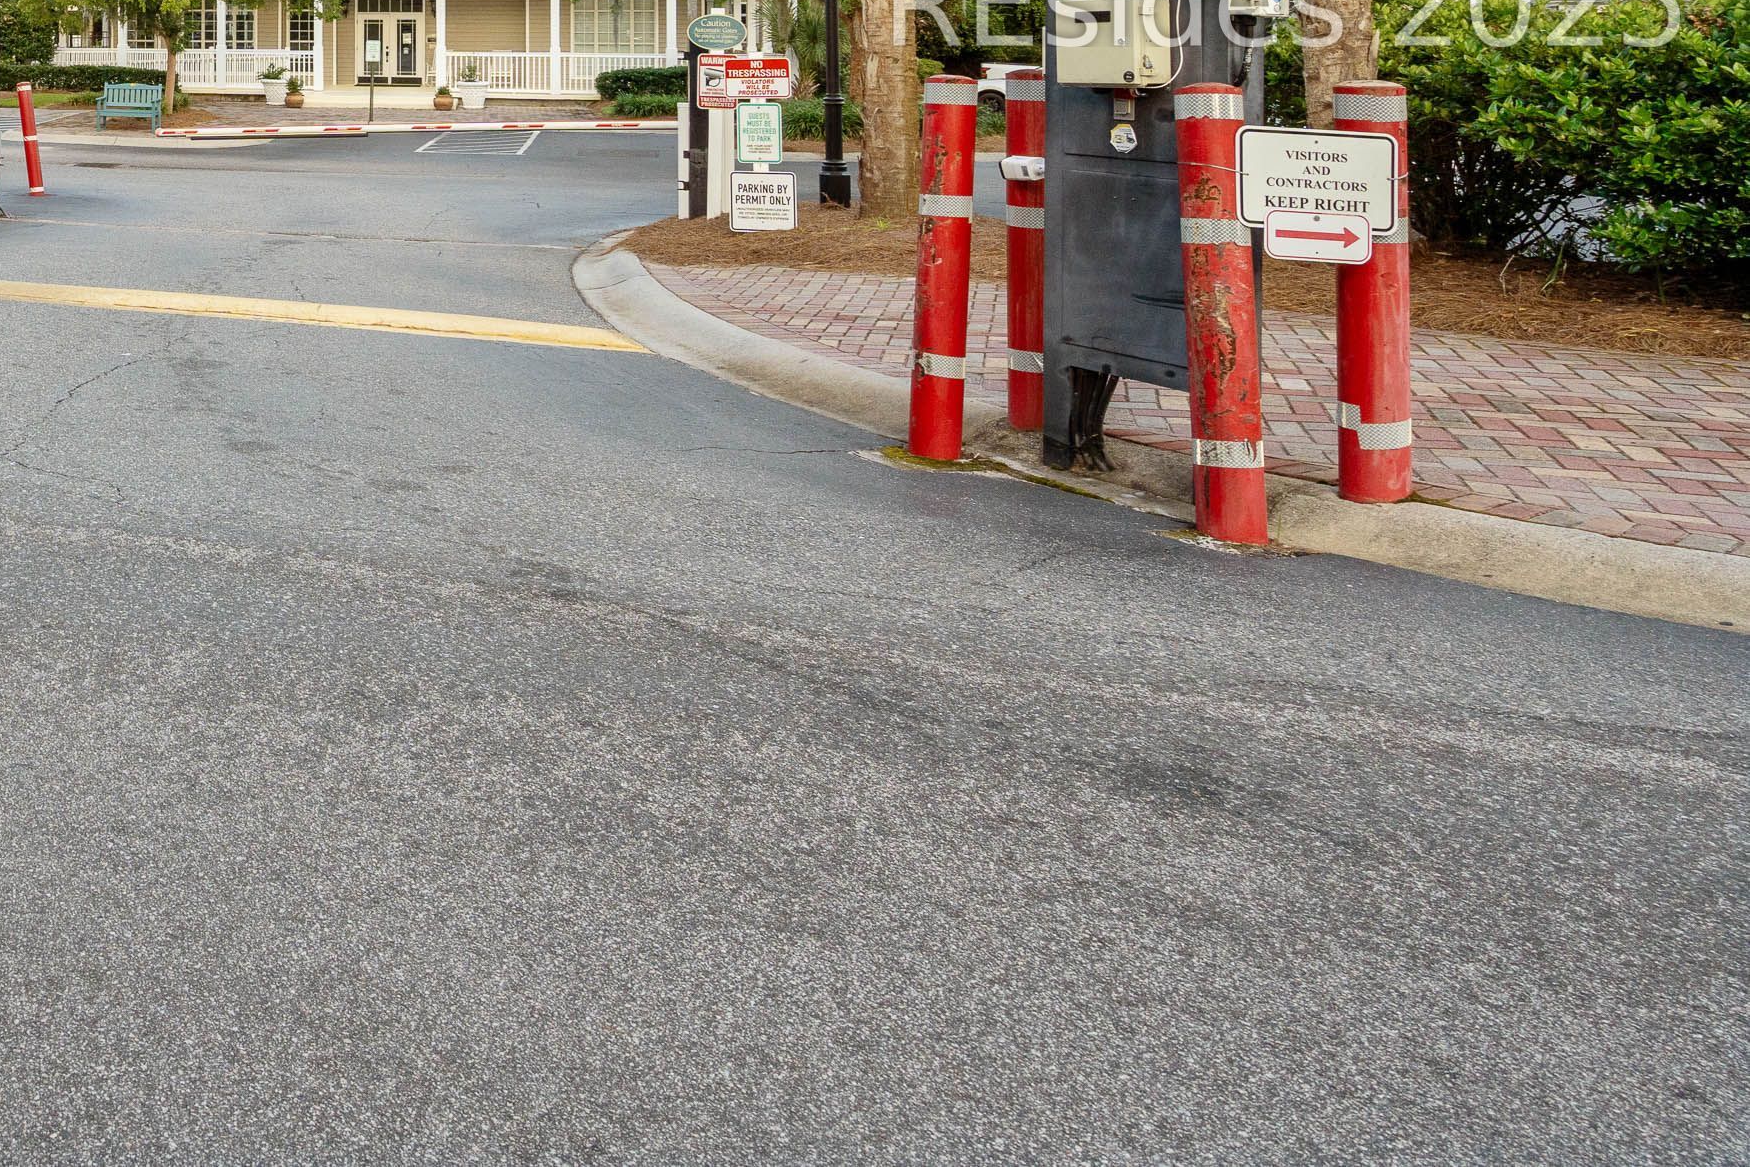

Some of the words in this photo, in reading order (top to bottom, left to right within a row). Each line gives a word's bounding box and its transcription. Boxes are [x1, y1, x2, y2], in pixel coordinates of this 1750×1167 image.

[700, 18, 731, 27] Caution
[750, 60, 763, 69] NO
[727, 68, 787, 77] TRESPASSING
[1286, 150, 1348, 163] VISITORS
[1302, 166, 1330, 176] AND
[737, 184, 774, 194] PARKING
[777, 184, 788, 194] BY
[1266, 177, 1368, 192] CONTRACTORS
[735, 195, 767, 205] PERMIT
[769, 196, 791, 206] ONLY
[1264, 195, 1308, 209] KEEP
[1314, 198, 1370, 213] RIGHT
